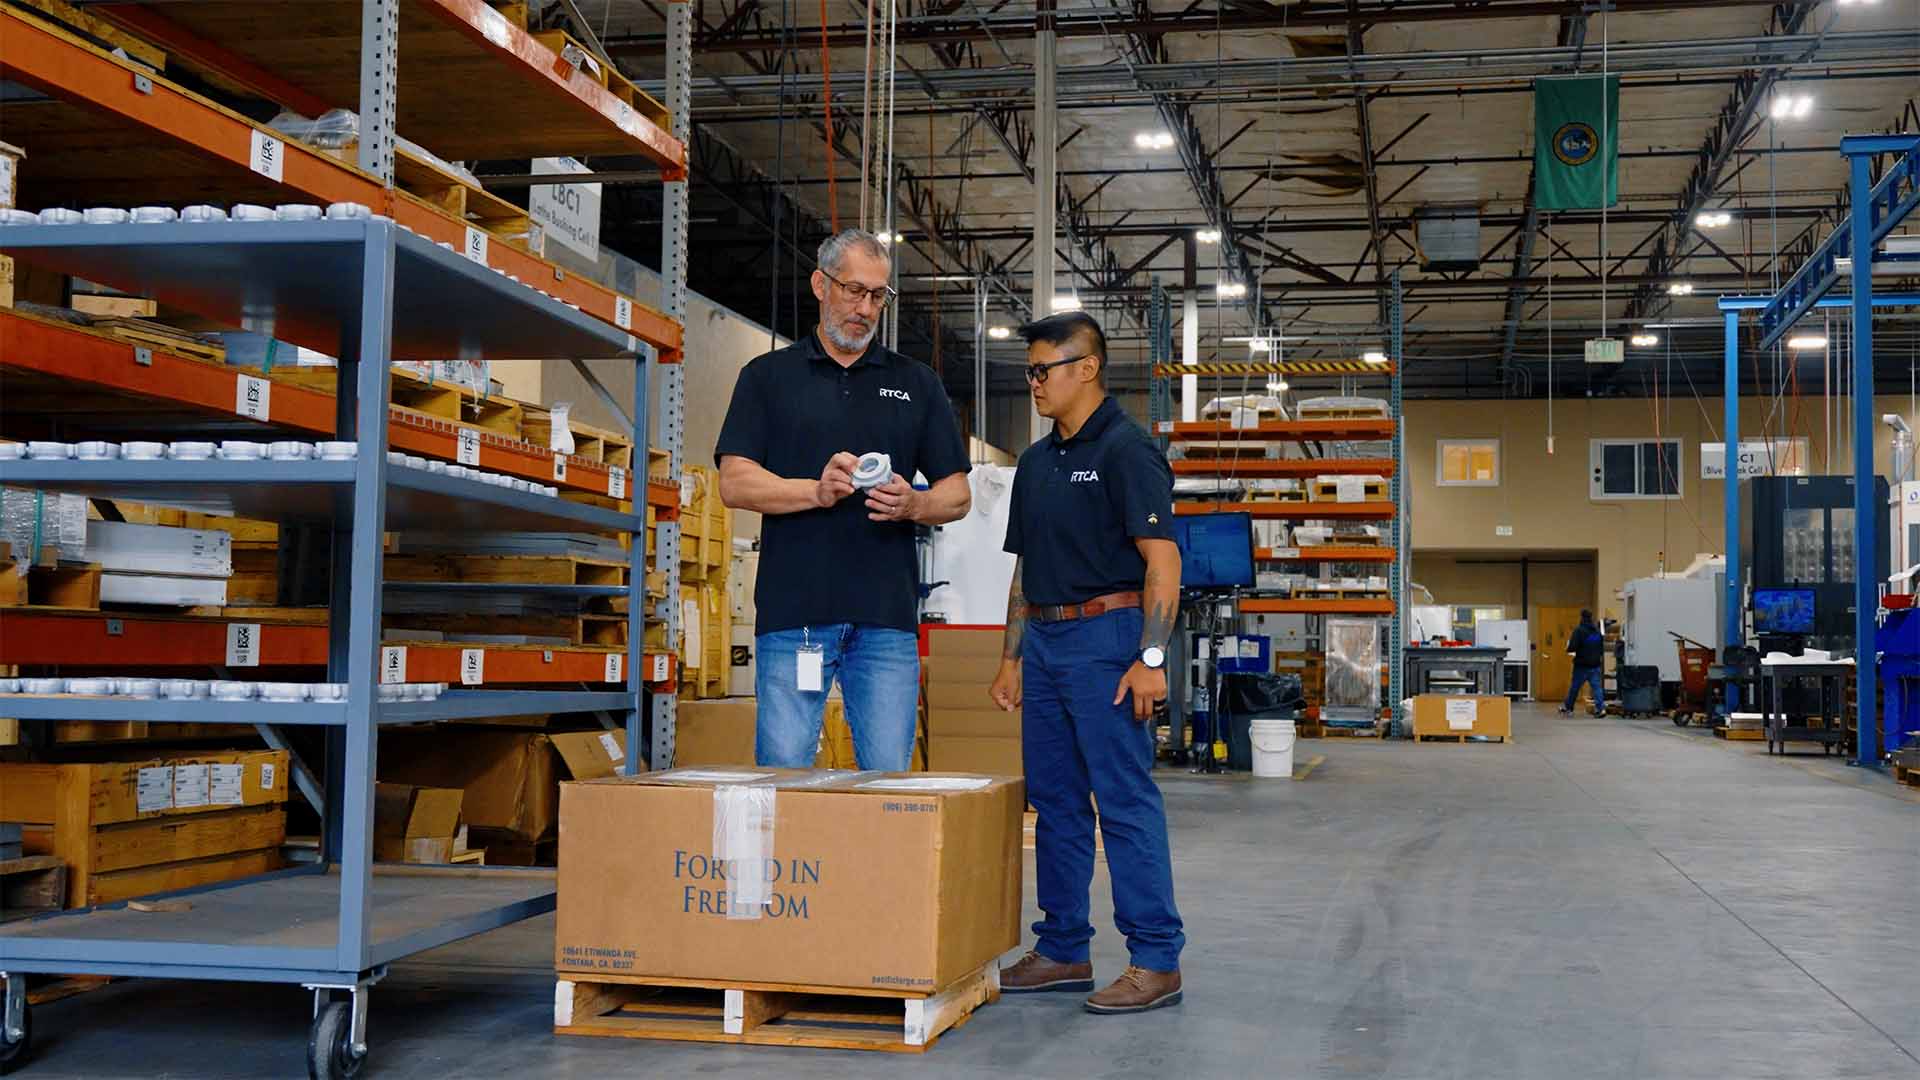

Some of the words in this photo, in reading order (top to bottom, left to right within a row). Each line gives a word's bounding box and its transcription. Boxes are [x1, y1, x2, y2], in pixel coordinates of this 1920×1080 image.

[552, 184, 580, 215] LBC1
[879, 388, 911, 401] RTCA
[1070, 470, 1099, 482] RTCA
[674, 850, 782, 883] FORD
[791, 859, 820, 884] IN
